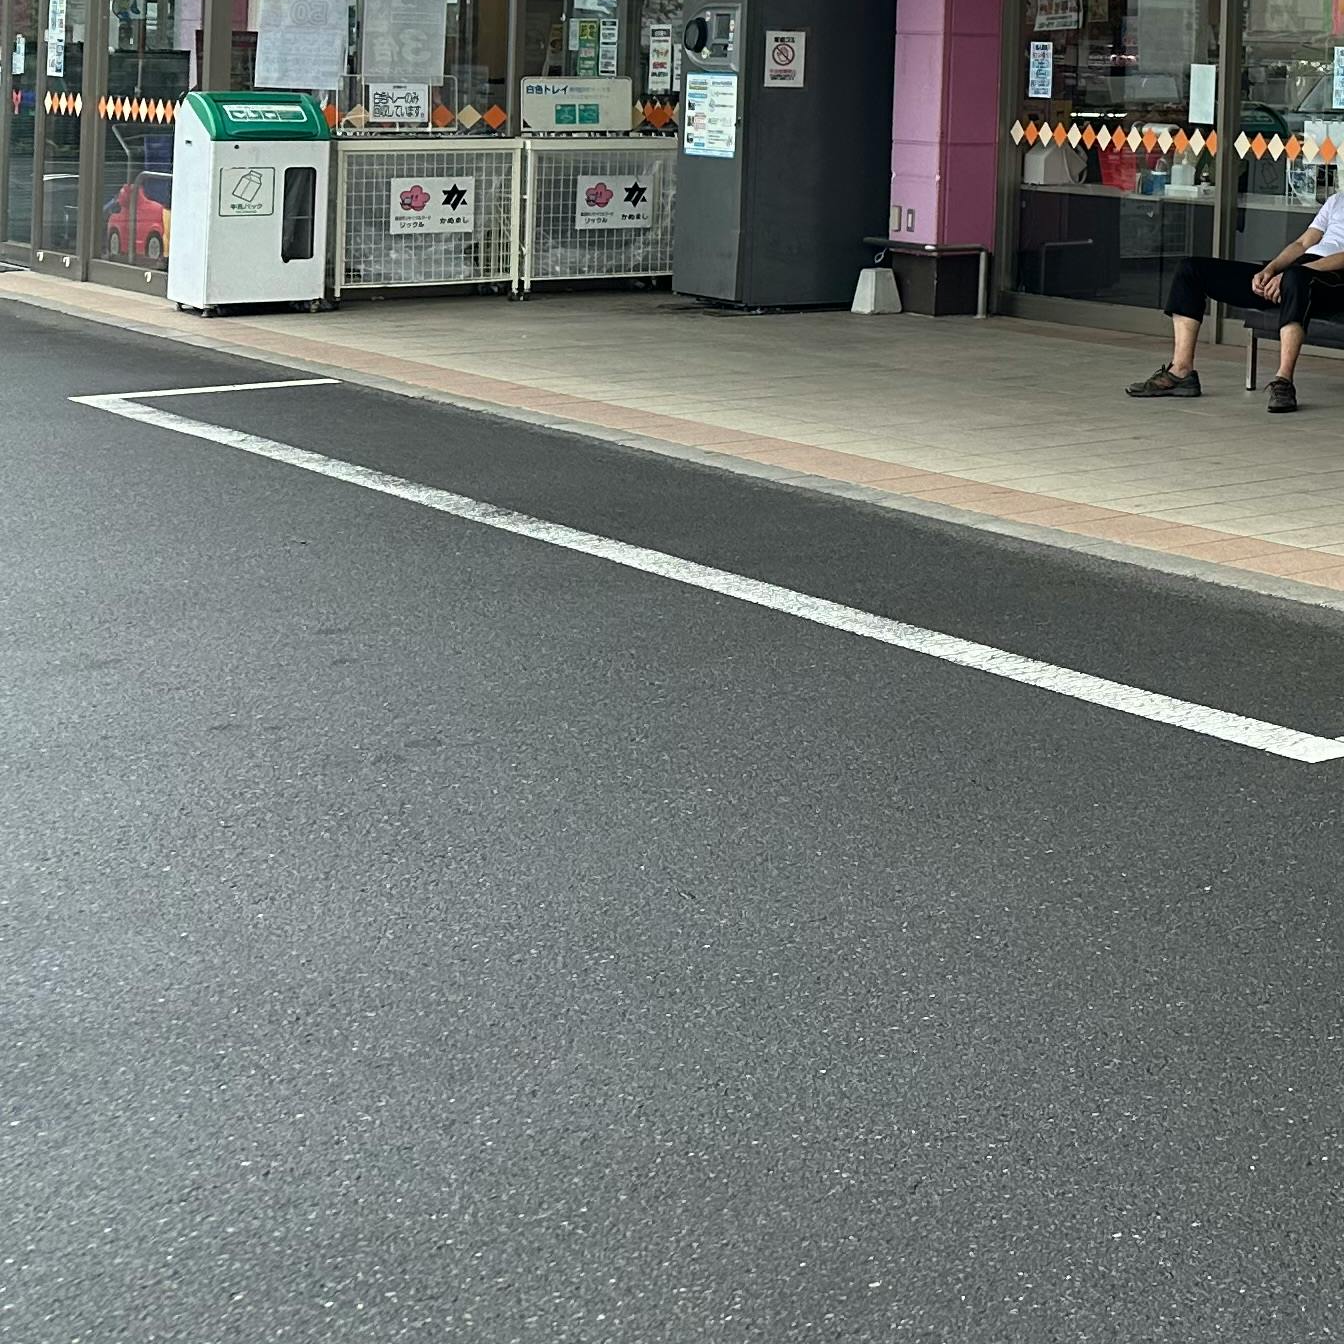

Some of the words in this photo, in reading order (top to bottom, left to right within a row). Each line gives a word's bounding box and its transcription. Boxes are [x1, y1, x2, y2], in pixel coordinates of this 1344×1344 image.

[526, 85, 568, 94] 白色トレイ
